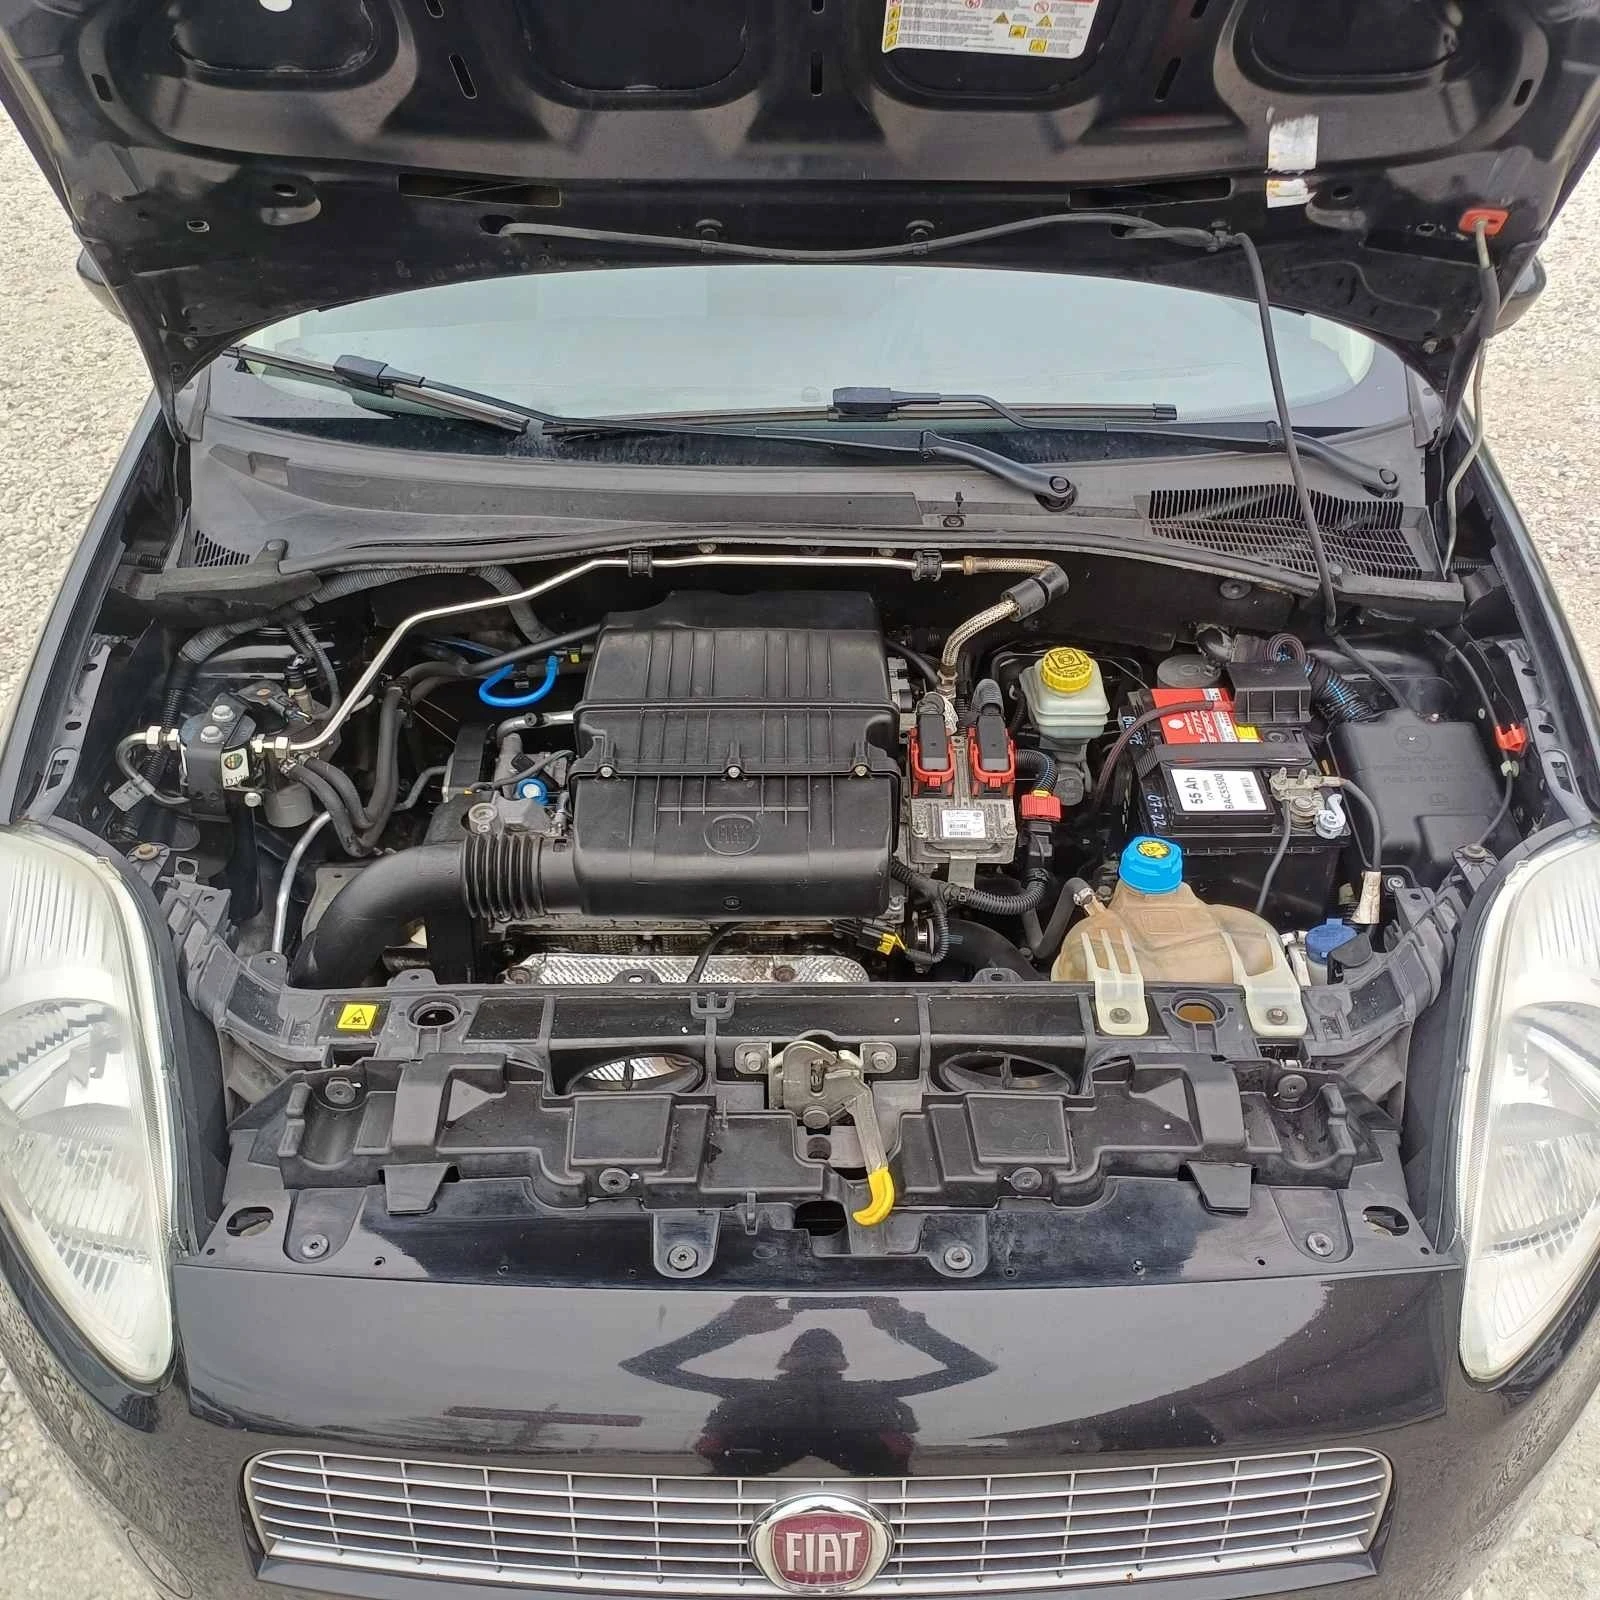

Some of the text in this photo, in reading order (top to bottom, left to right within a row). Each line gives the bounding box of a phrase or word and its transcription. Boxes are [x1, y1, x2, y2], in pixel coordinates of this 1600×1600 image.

[1184, 777, 1203, 804] 55 Ah
[785, 1532, 862, 1573] FIAT
